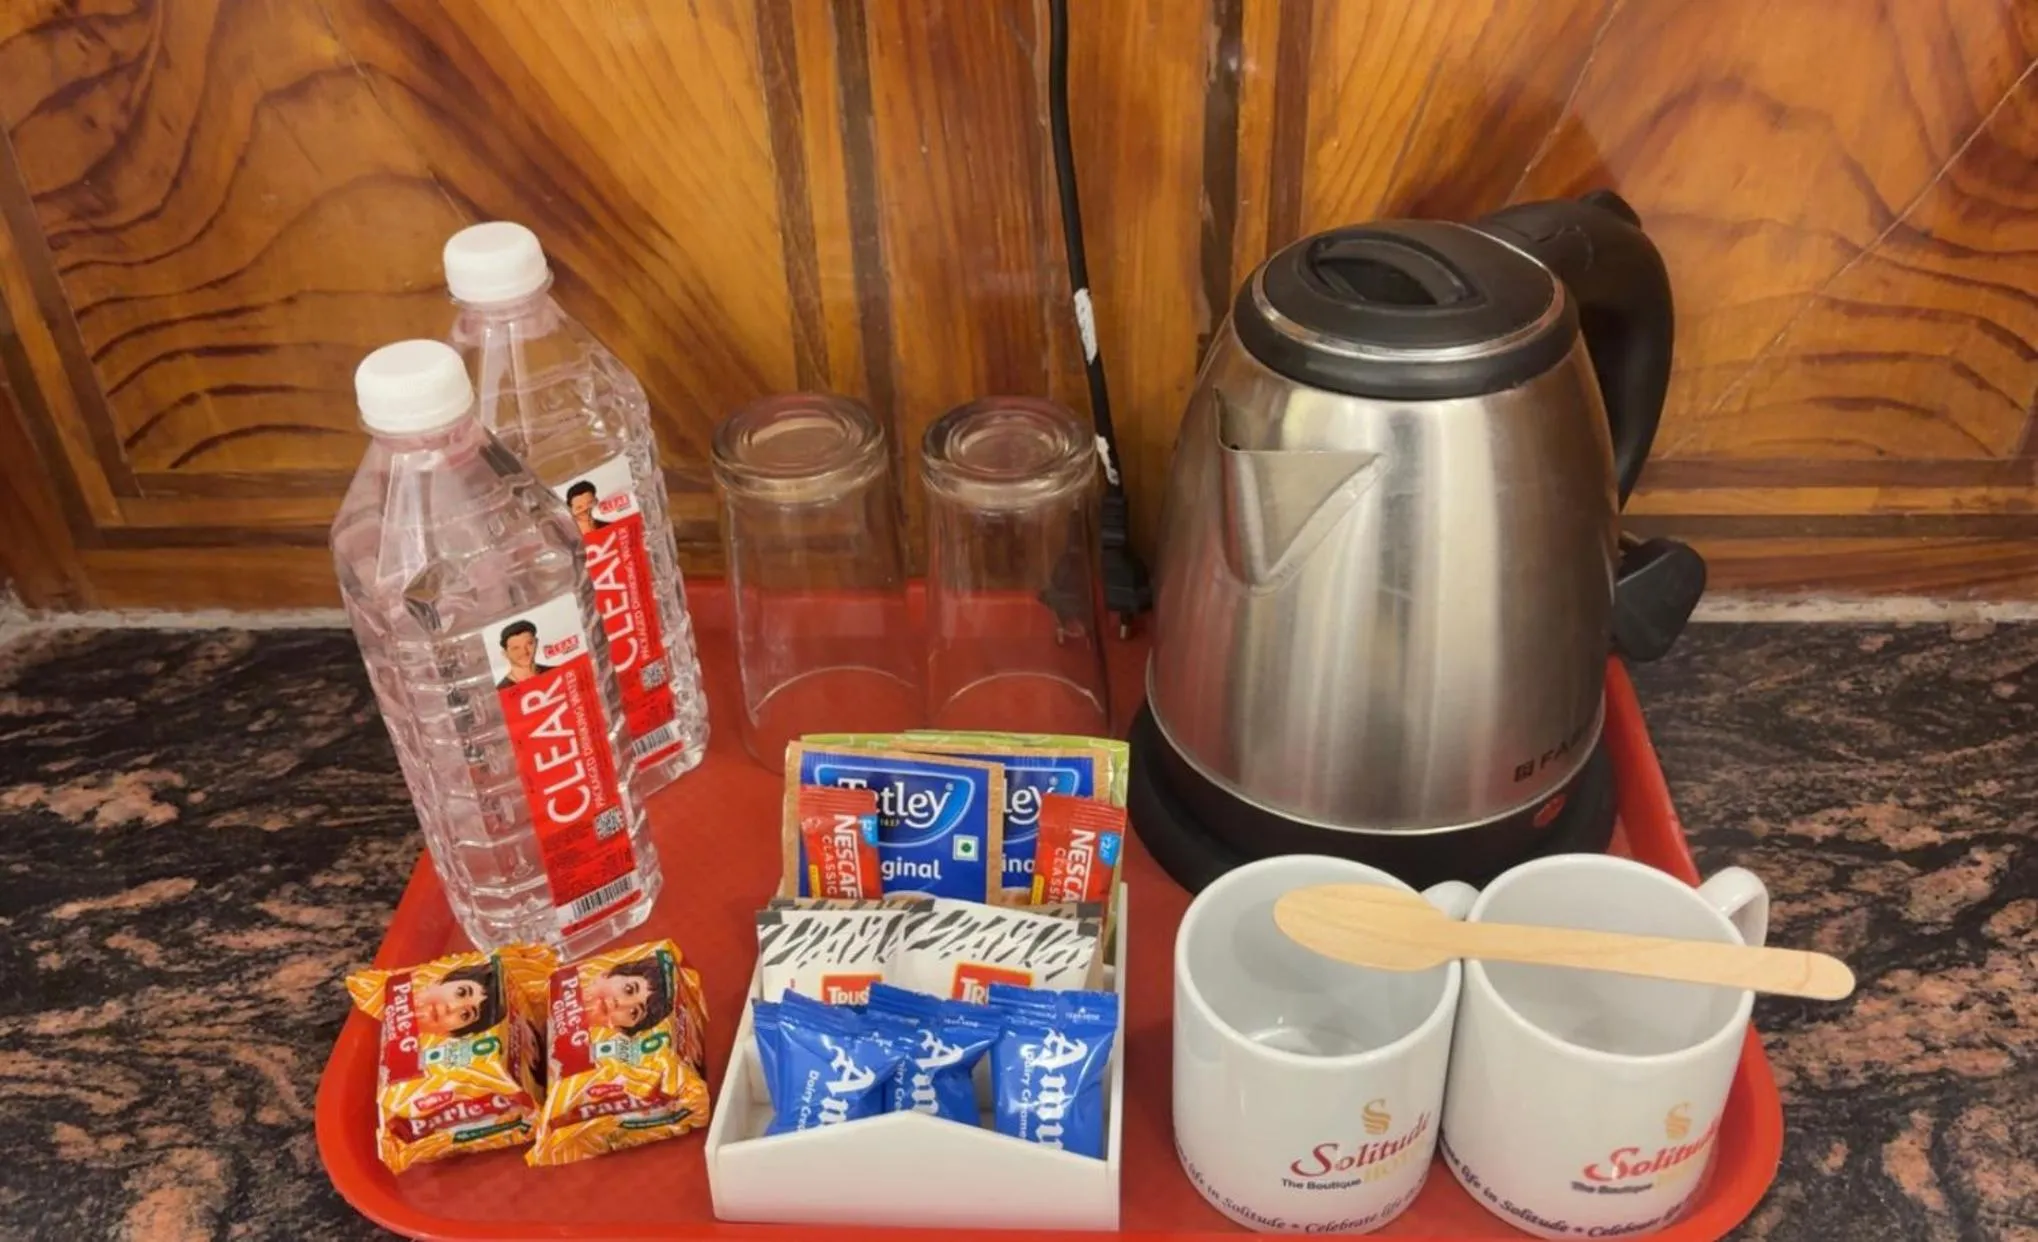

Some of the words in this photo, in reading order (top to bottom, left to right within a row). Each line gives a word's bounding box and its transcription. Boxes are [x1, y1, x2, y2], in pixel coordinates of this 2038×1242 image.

[585, 531, 638, 672] CLEAR
[520, 675, 591, 823] CLEAR
[837, 778, 951, 828] Ttley
[822, 834, 838, 895] CLASSIC
[833, 814, 860, 899] NESCAF
[881, 857, 942, 881] ginal
[1049, 847, 1067, 904] CLASSI
[393, 982, 418, 1053] Parle-G
[561, 976, 589, 1047] Parle-G
[802, 1069, 820, 1103] Dairy
[1282, 1178, 1303, 1190] The
[1306, 1178, 1361, 1191] Boutique
[1222, 1198, 1287, 1229] Solitude
[1305, 1213, 1379, 1235] Celebrate
[1499, 1200, 1570, 1232] Solitude
